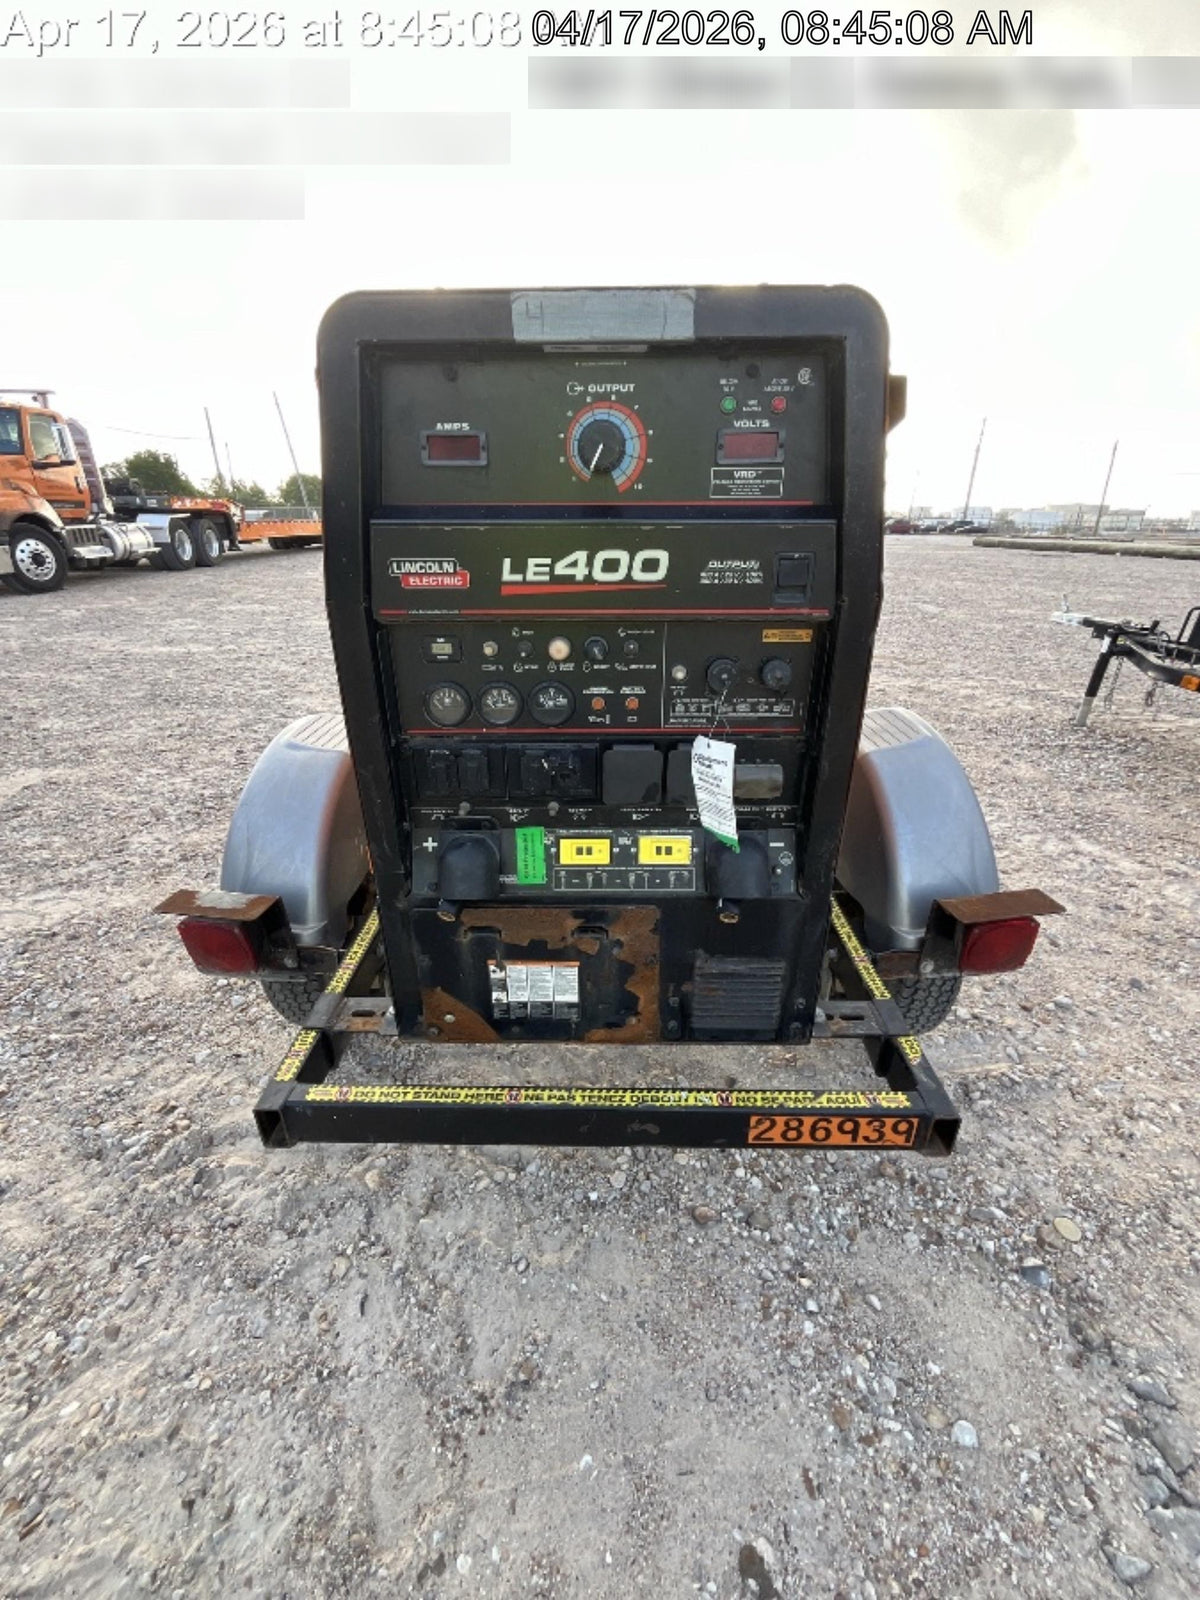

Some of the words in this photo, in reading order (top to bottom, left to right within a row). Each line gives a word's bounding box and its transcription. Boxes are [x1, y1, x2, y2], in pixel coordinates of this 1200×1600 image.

[587, 383, 636, 392] OUTPUT
[435, 422, 471, 432] AMPS
[733, 419, 771, 428] VOLTS
[392, 561, 455, 574] LINCOLN
[501, 549, 670, 583] LE400
[408, 575, 464, 586] ELECTRIC
[353, 1090, 376, 1098] DO
[378, 1090, 410, 1098] NOT
[412, 1091, 461, 1100] STAND
[524, 1093, 544, 1102] NE
[578, 1094, 627, 1103] TENEZ
[735, 1096, 758, 1105] NO
[750, 1117, 915, 1145] 286939
